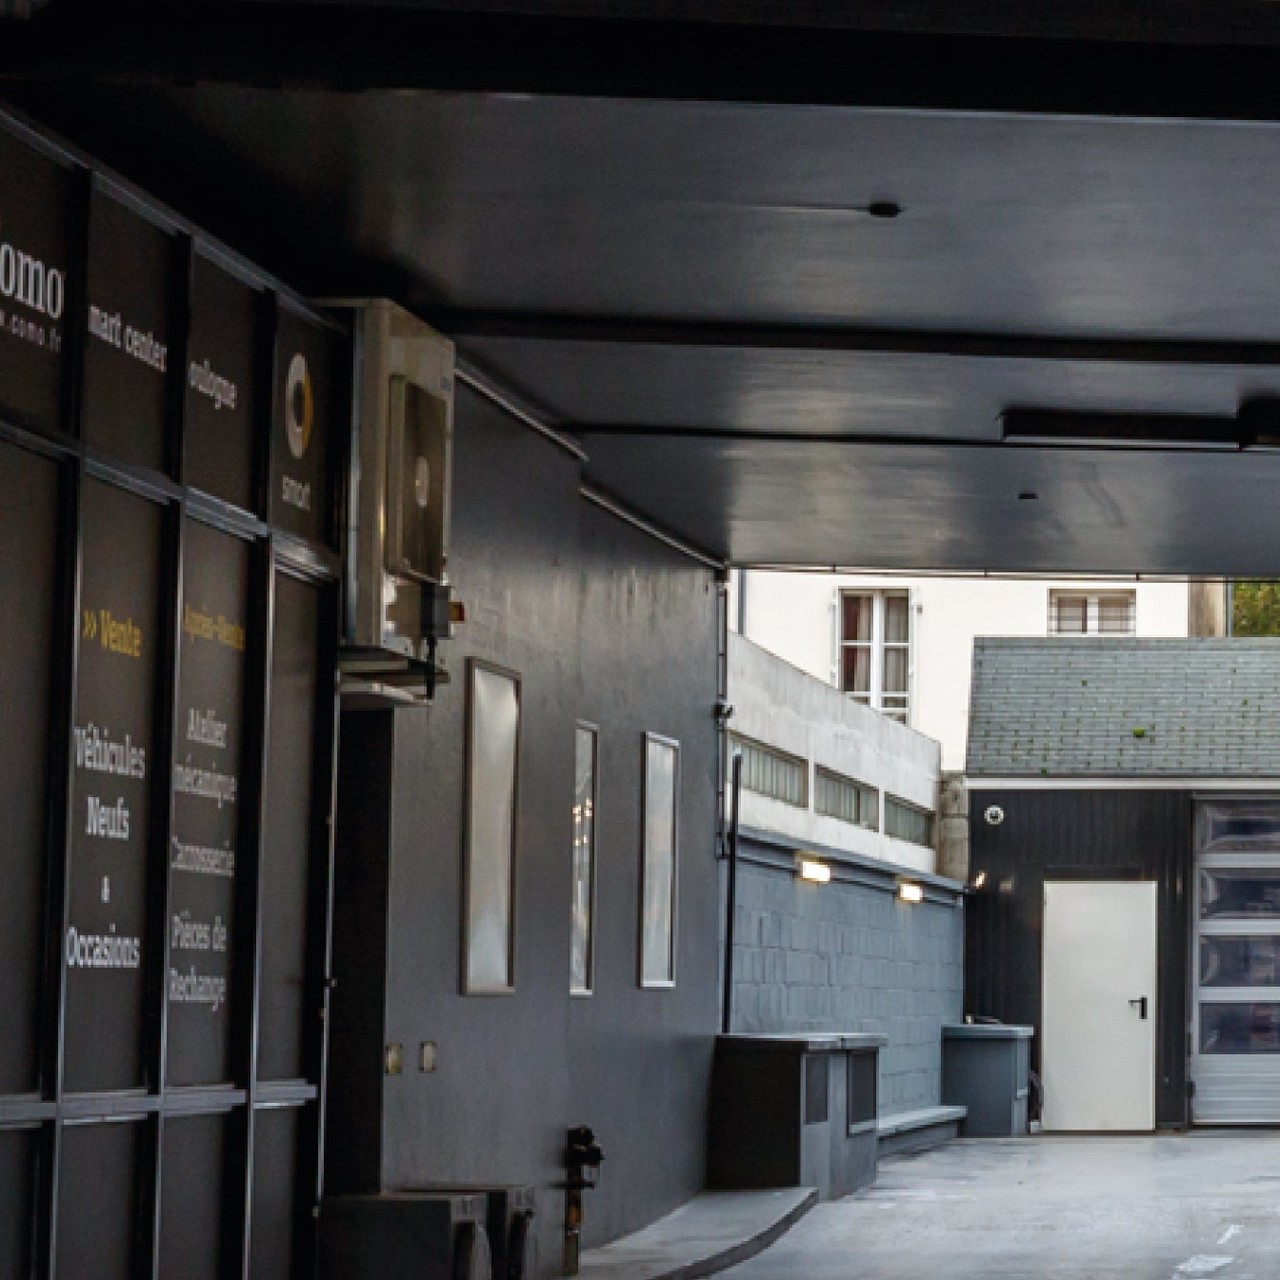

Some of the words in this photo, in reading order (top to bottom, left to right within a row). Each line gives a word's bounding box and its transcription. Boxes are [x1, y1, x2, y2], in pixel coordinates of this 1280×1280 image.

[0, 242, 62, 321] omo
[73, 720, 145, 779] Véhicules
[86, 795, 130, 841] Neufs
[67, 923, 141, 969] Occasions
